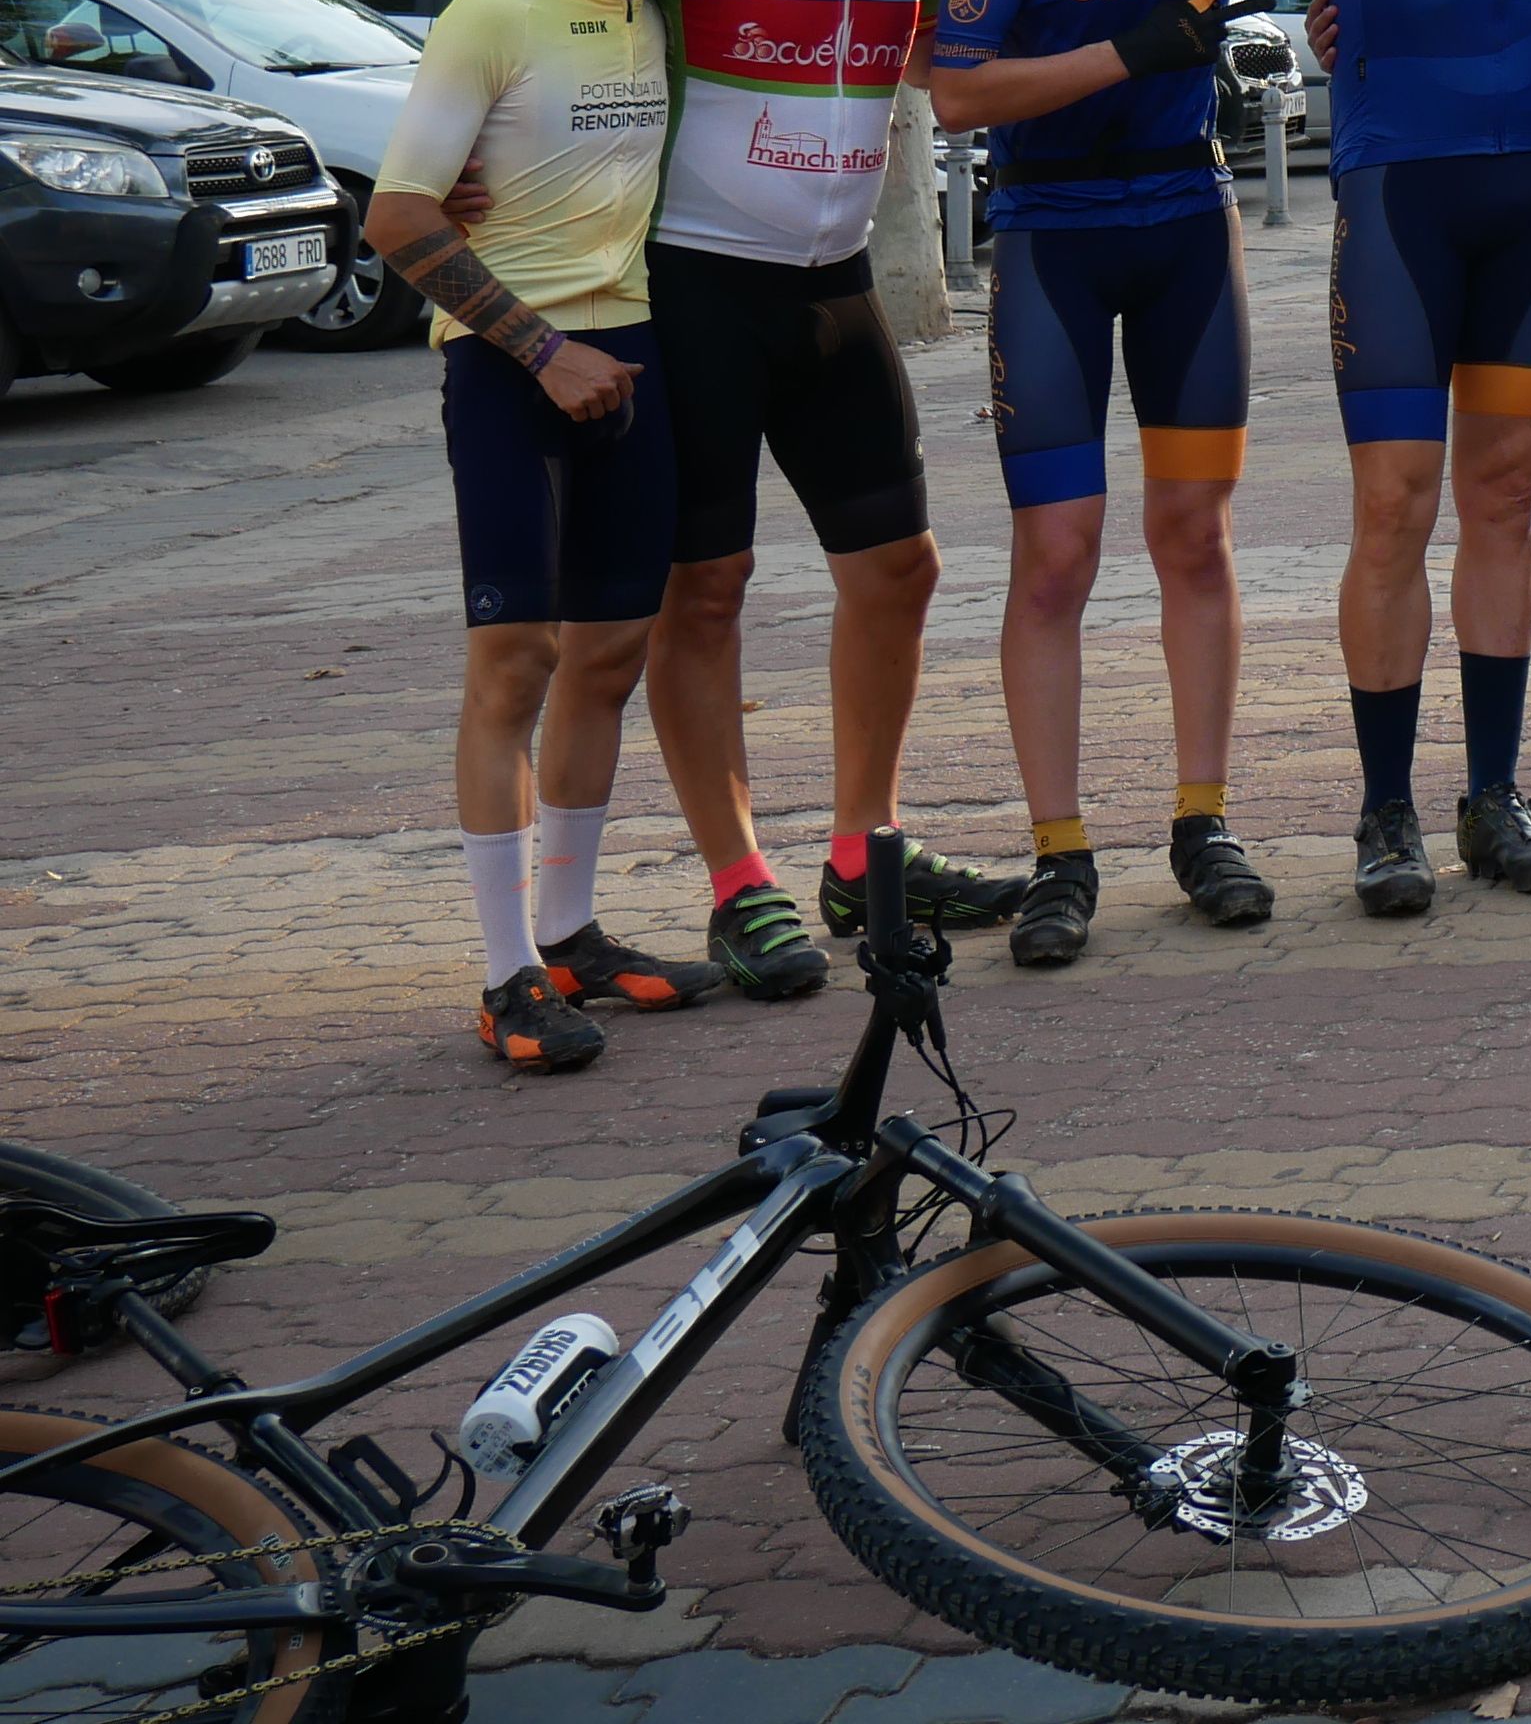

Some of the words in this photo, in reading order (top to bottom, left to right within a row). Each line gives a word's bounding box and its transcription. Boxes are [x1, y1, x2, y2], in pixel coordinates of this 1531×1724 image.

[570, 20, 608, 35] GOBIK
[254, 242, 288, 273] 2688
[297, 237, 322, 266] FRD
